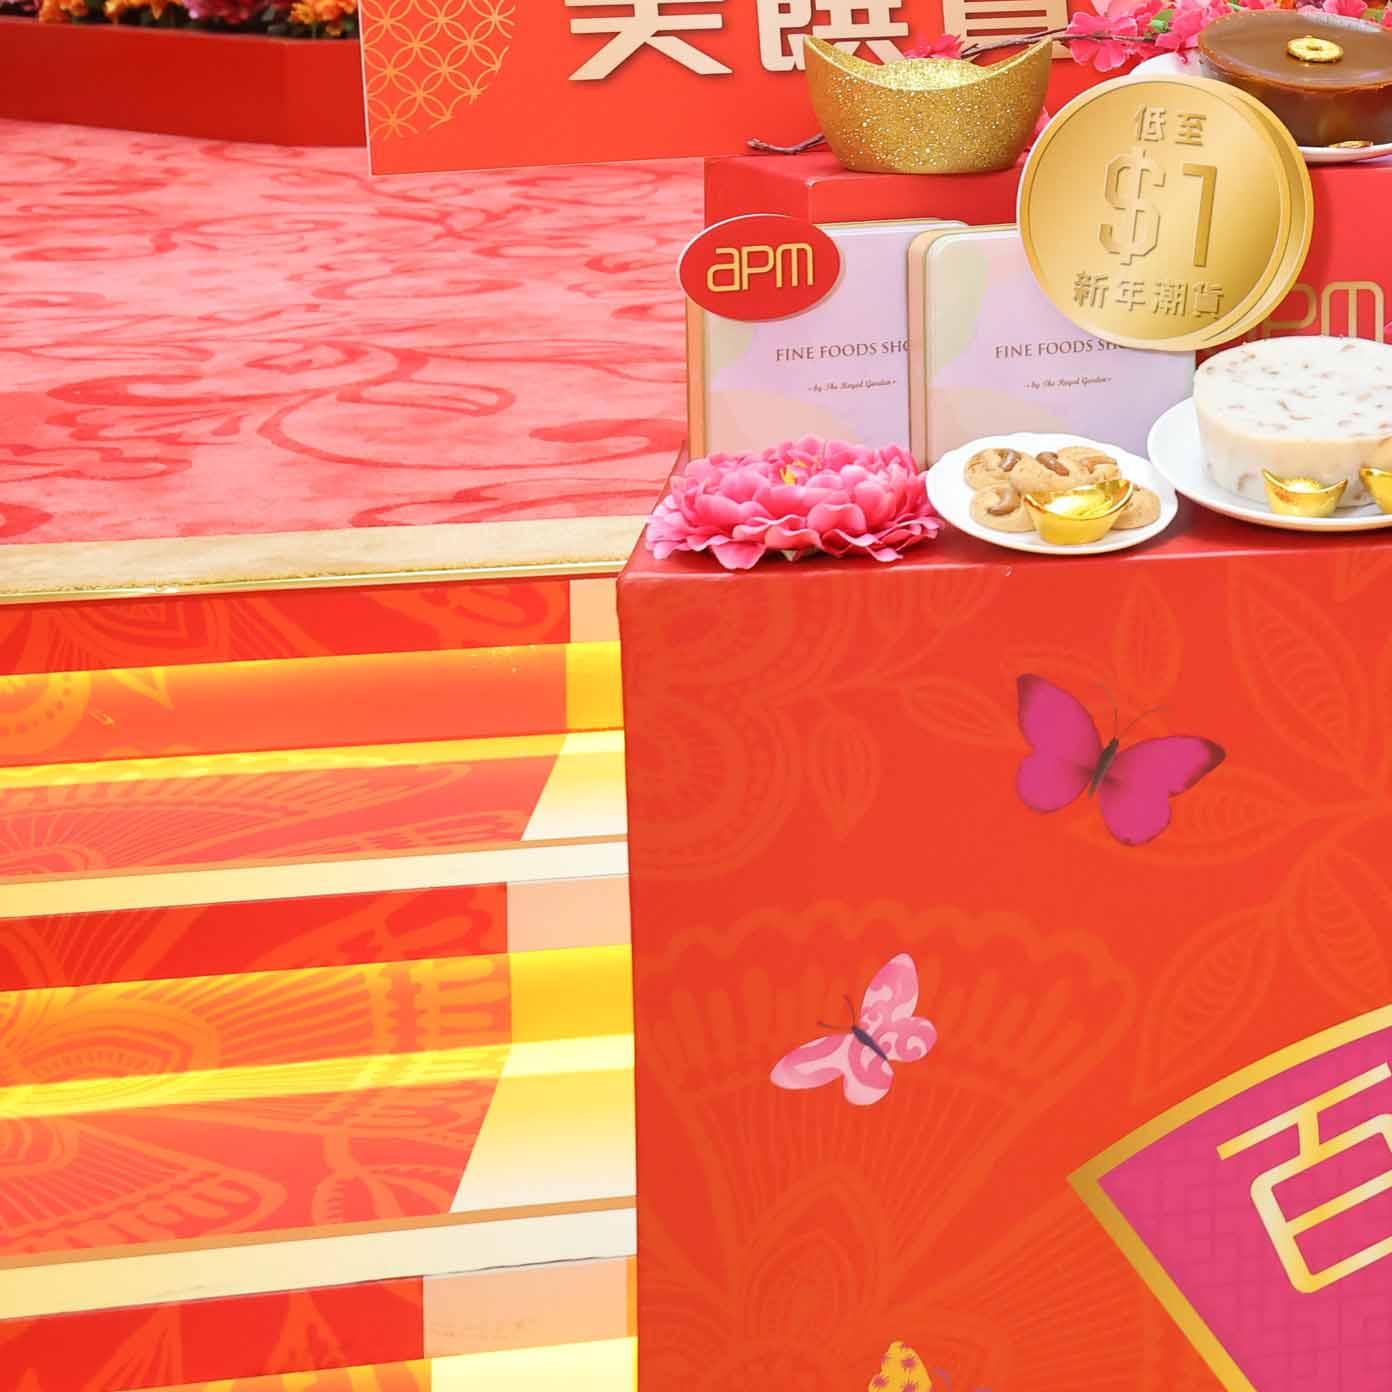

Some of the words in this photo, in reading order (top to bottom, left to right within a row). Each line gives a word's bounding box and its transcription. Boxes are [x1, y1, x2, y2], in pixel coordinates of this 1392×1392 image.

[1134, 105, 1207, 147] 低至
[1099, 145, 1218, 268] $1
[1073, 271, 1225, 320] 新年潮貨
[775, 346, 815, 362] FINE
[820, 342, 877, 359] FOODS
[995, 344, 1034, 360] FINE
[1038, 341, 1095, 357] FOODS
